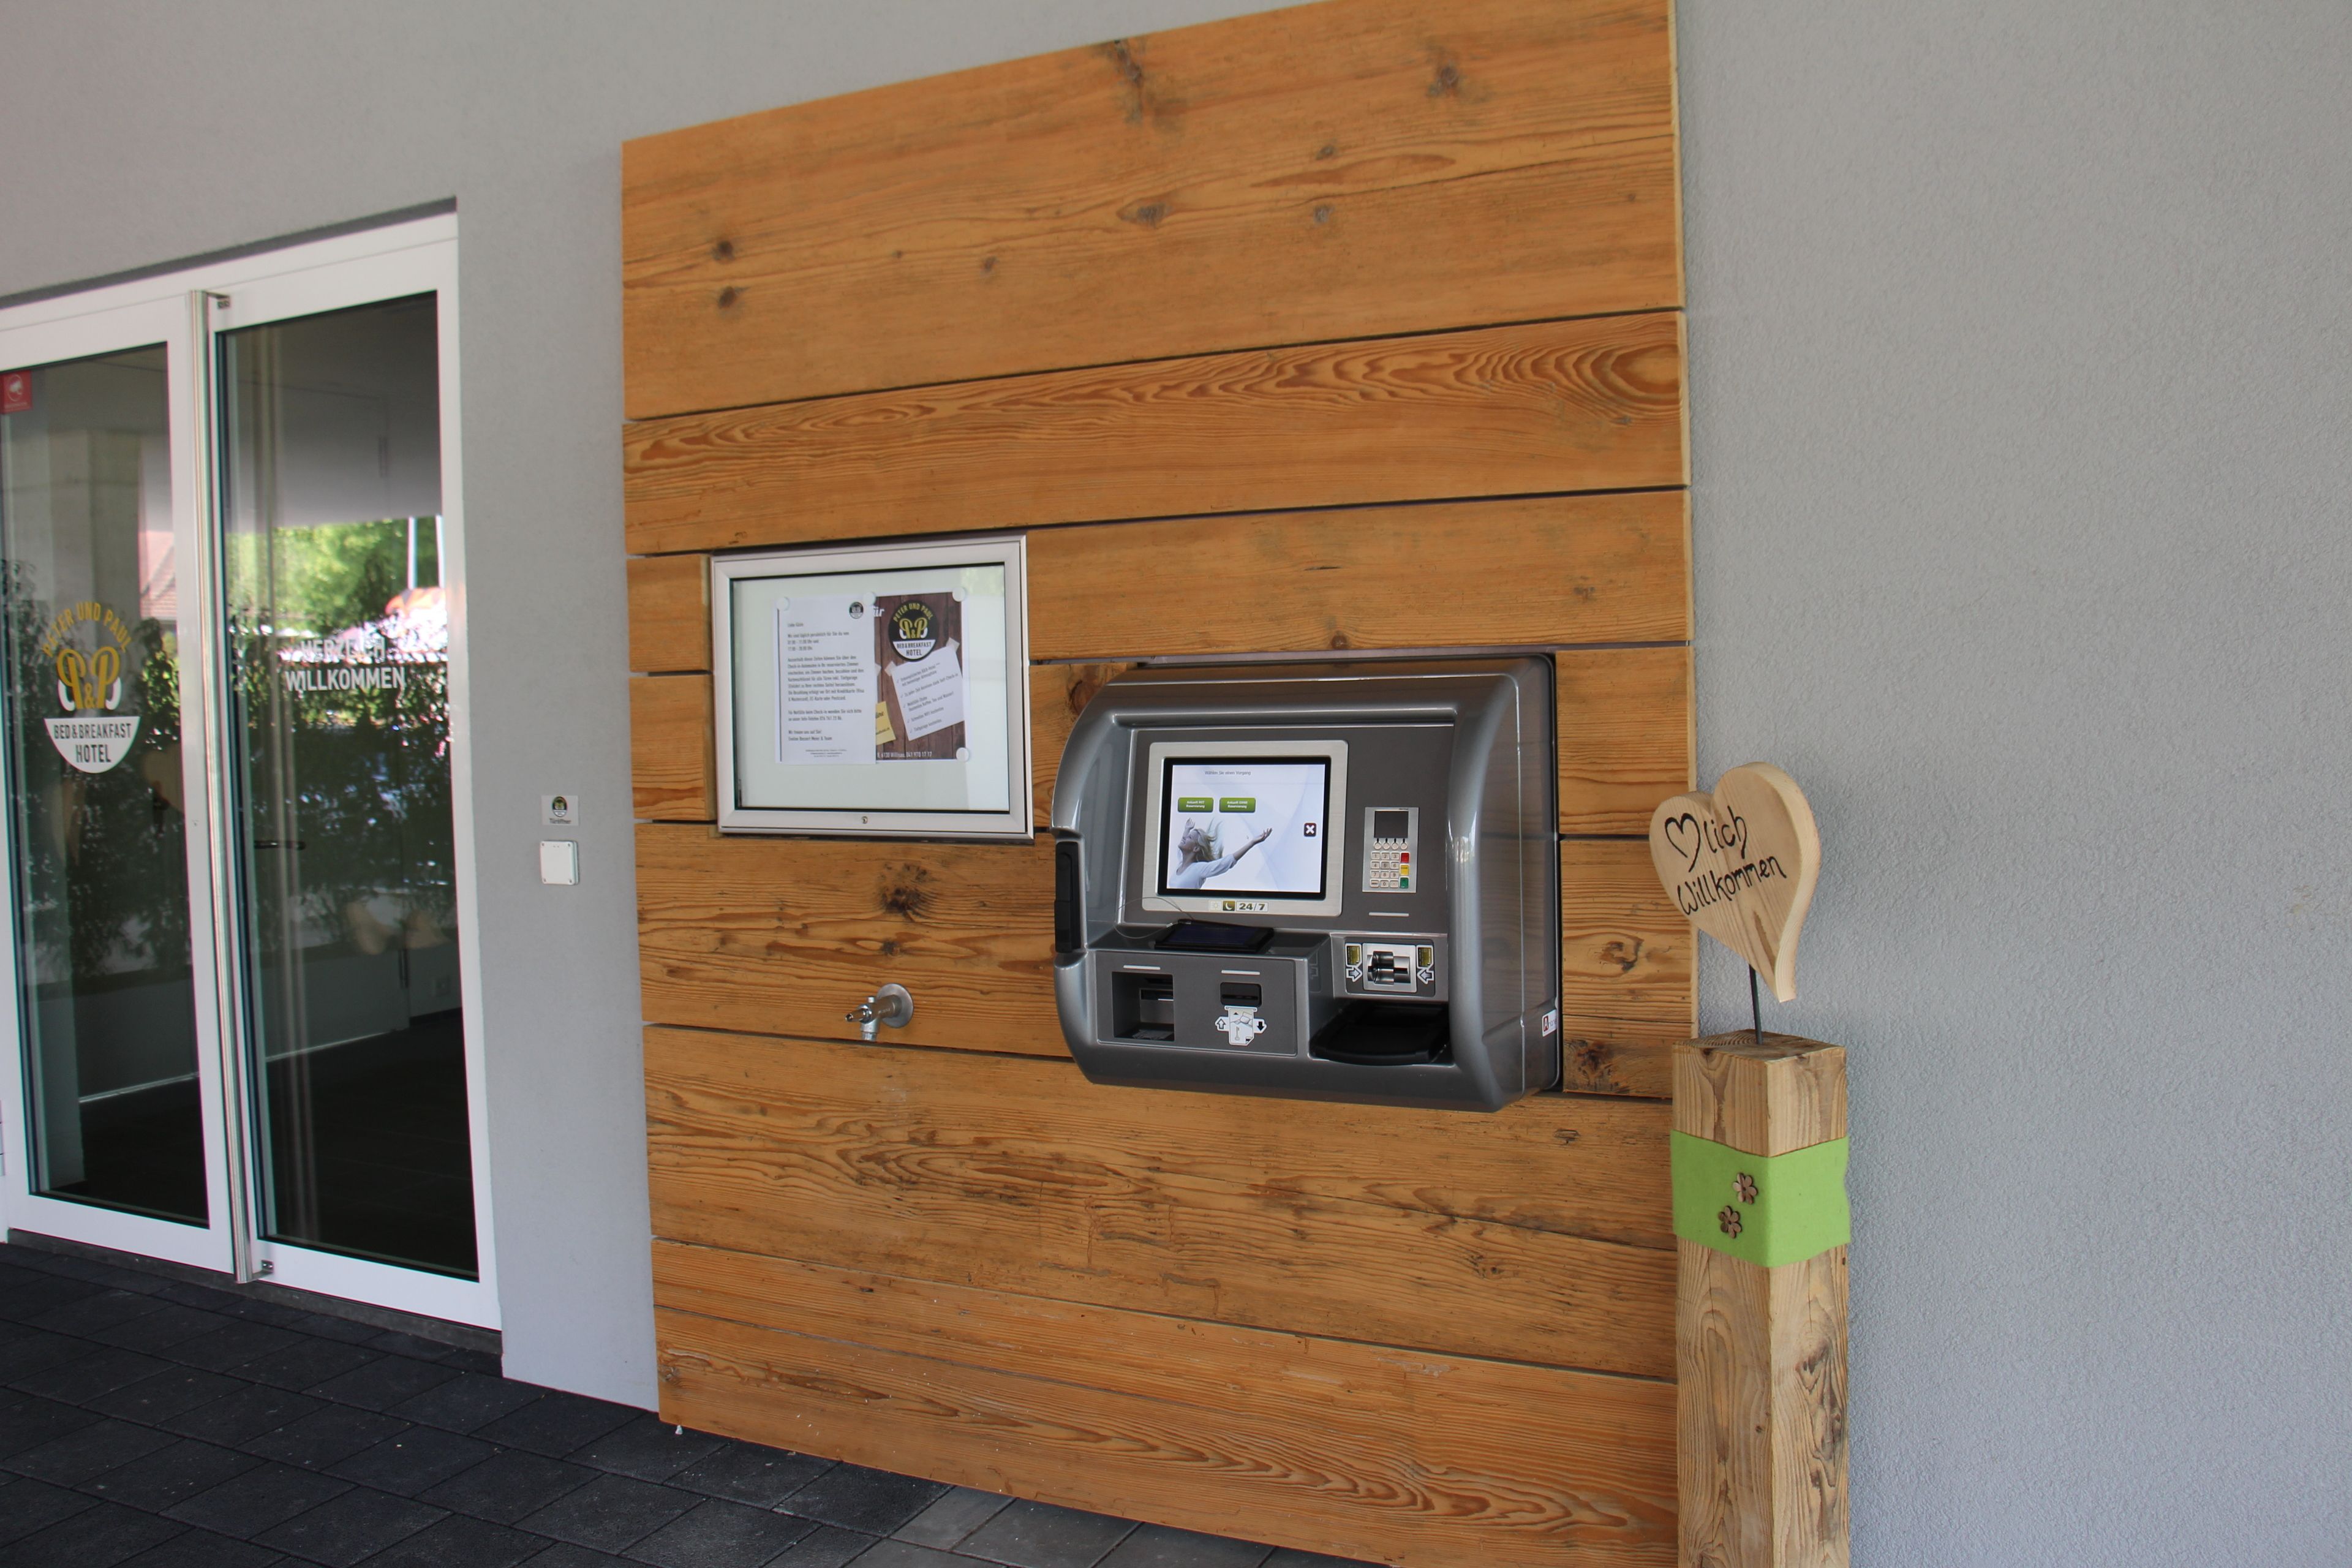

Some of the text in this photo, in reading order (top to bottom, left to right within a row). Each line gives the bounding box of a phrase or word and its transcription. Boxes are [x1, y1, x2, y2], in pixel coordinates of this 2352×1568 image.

[892, 605, 908, 622] PETER
[920, 605, 933, 620] PAUL
[42, 601, 132, 658] PETER UND PAUL
[285, 666, 405, 692] WILLKOMMEN
[75, 744, 111, 764] HOTEL
[1703, 805, 1748, 859] lich
[1676, 855, 1787, 916] Willkommen
[1239, 902, 1265, 911] 24/7
